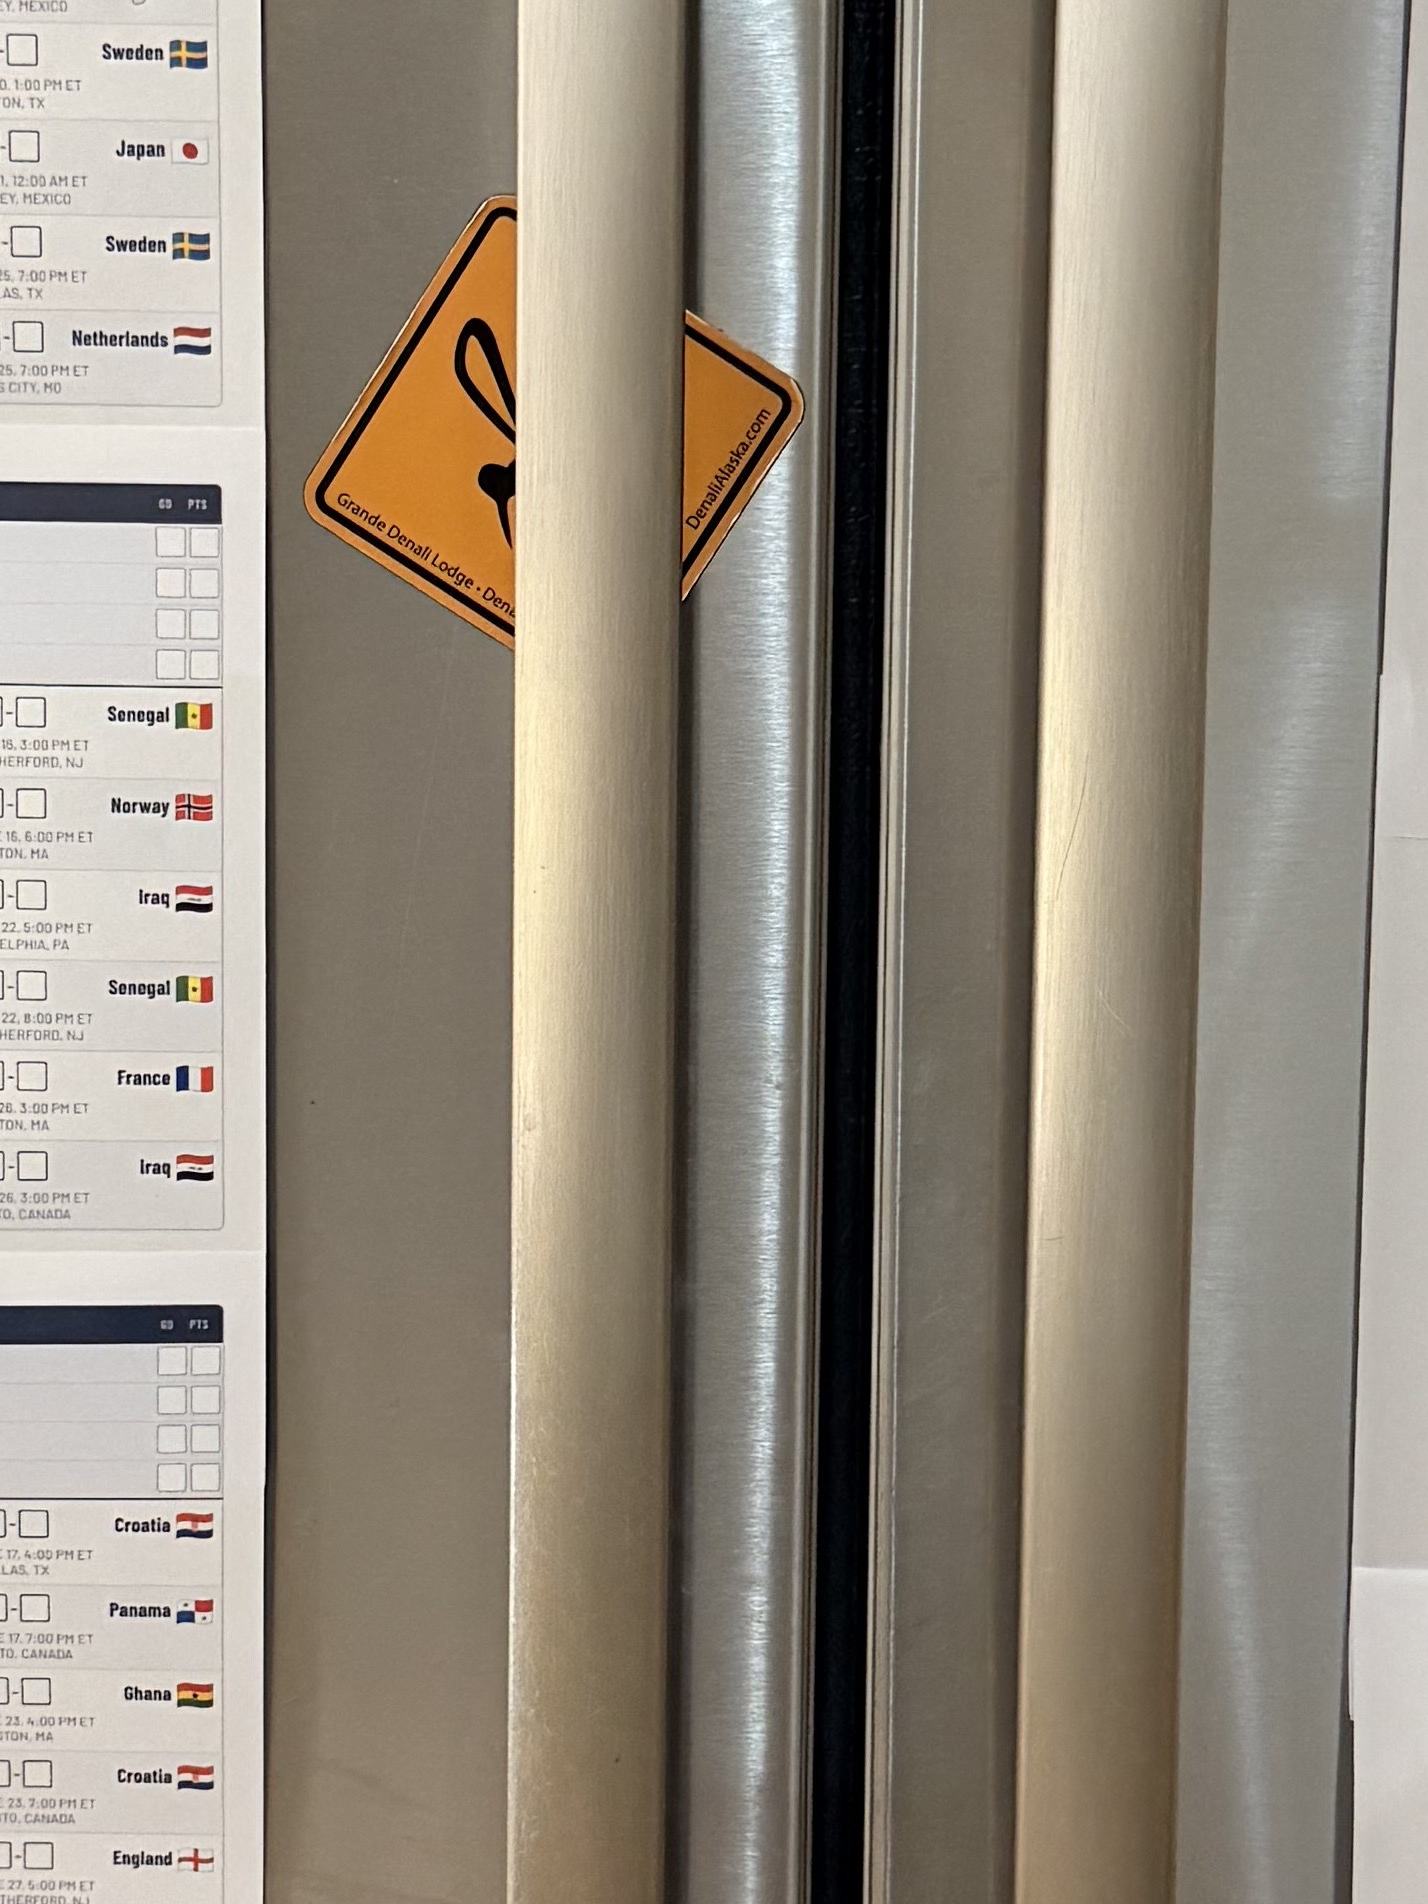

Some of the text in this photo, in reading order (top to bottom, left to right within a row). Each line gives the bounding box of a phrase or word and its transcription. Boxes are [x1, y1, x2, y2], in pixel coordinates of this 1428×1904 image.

[685, 408, 771, 530] DenaliAlaska.com
[337, 492, 386, 532] Grande
[387, 525, 432, 561] Denali
[432, 553, 475, 589] Lodge
[30, 848, 49, 860] MA
[19, 1209, 70, 1220] CANADA
